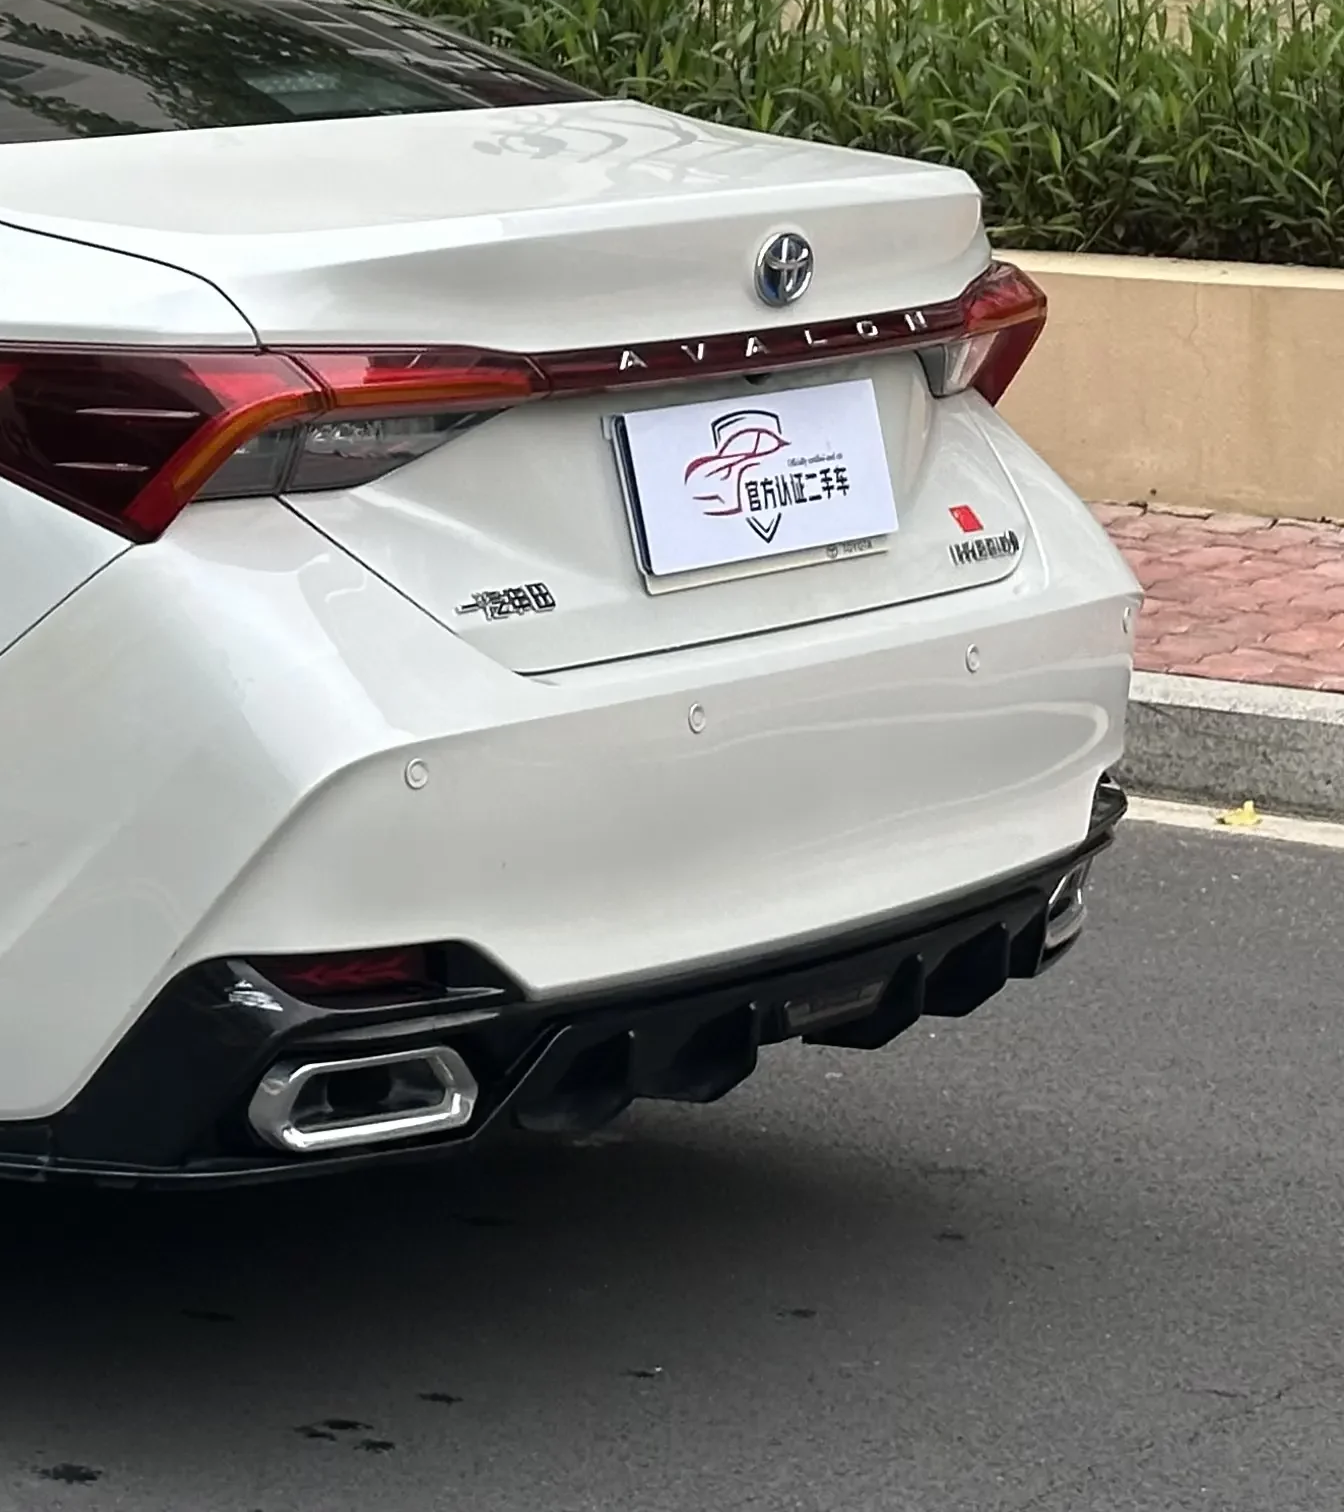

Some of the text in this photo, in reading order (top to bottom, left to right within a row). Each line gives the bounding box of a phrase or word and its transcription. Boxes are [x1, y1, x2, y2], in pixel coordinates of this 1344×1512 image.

[619, 310, 928, 371] AVALON
[745, 466, 850, 512] 官方认证二手车
